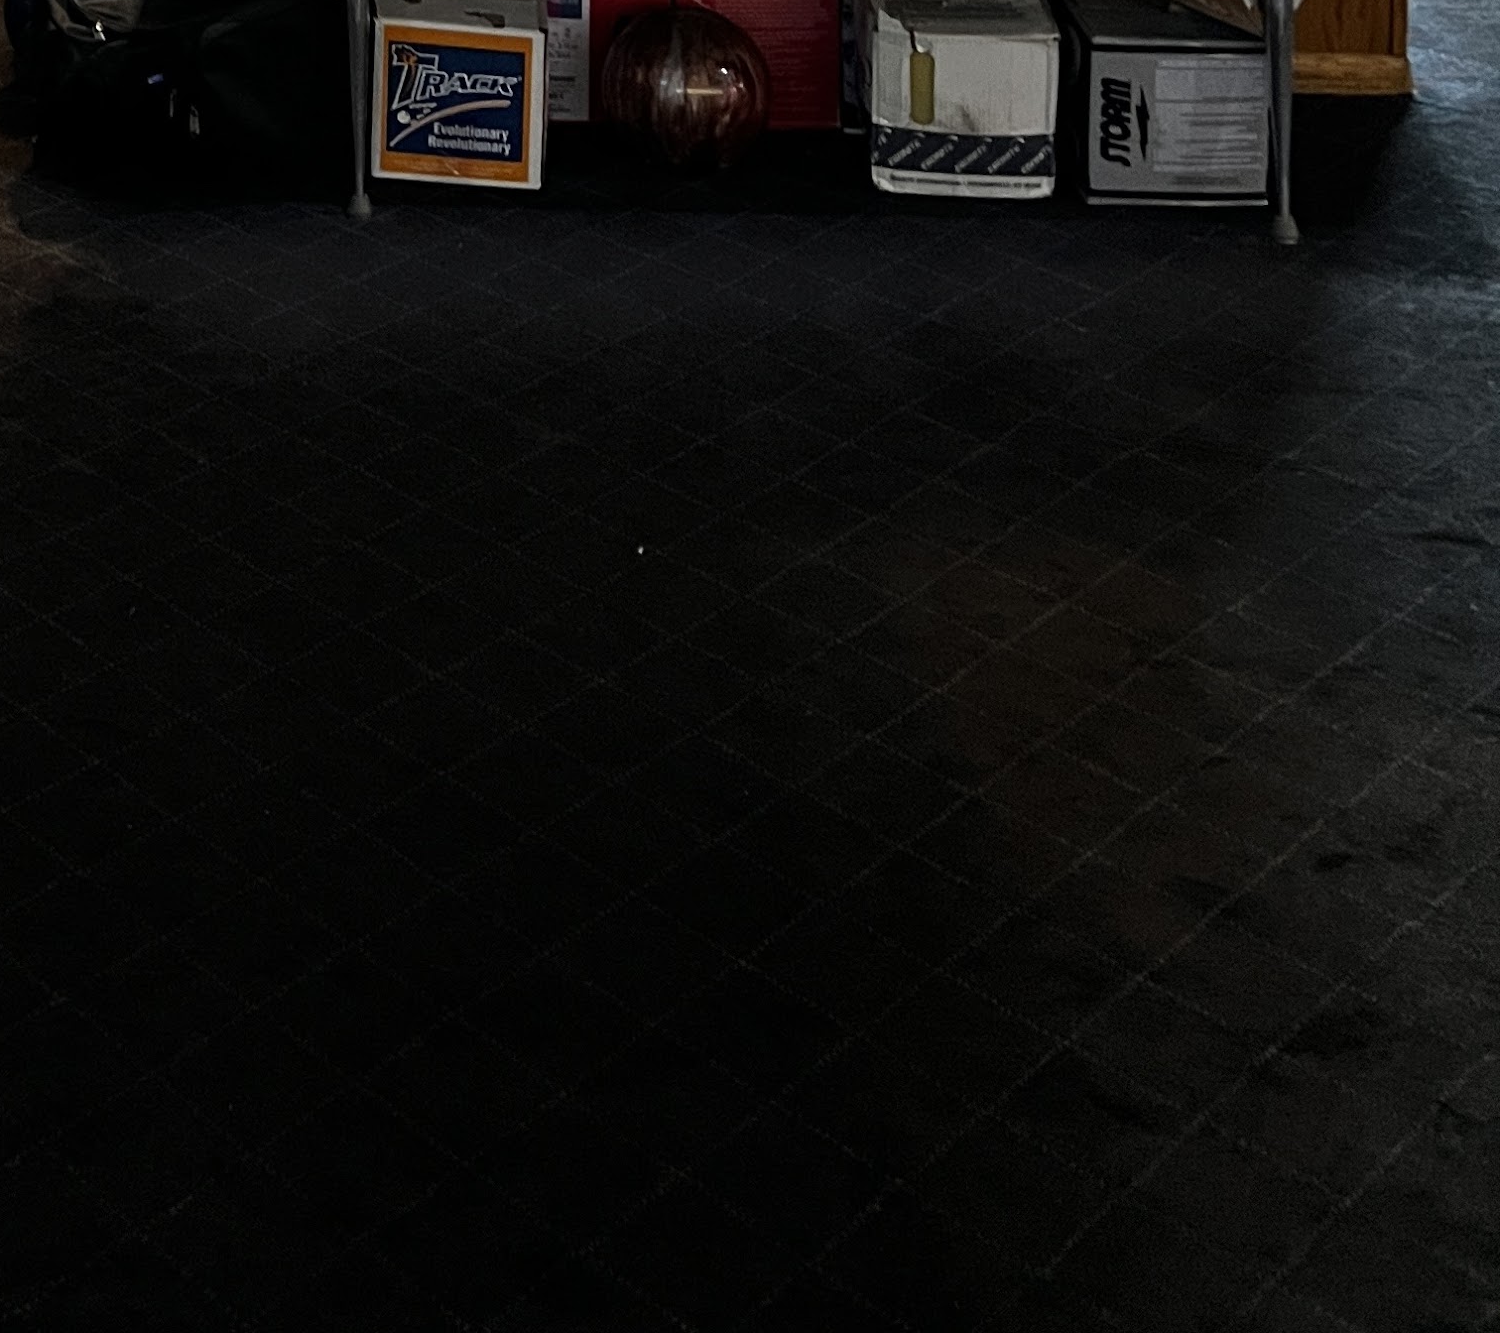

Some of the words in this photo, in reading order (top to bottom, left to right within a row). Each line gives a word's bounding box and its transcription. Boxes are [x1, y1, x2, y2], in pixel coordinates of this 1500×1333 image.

[392, 44, 519, 111] TRACK
[433, 122, 509, 142] Evolutionary
[1101, 77, 1131, 167] STORM
[428, 135, 511, 156] Revolutionary
